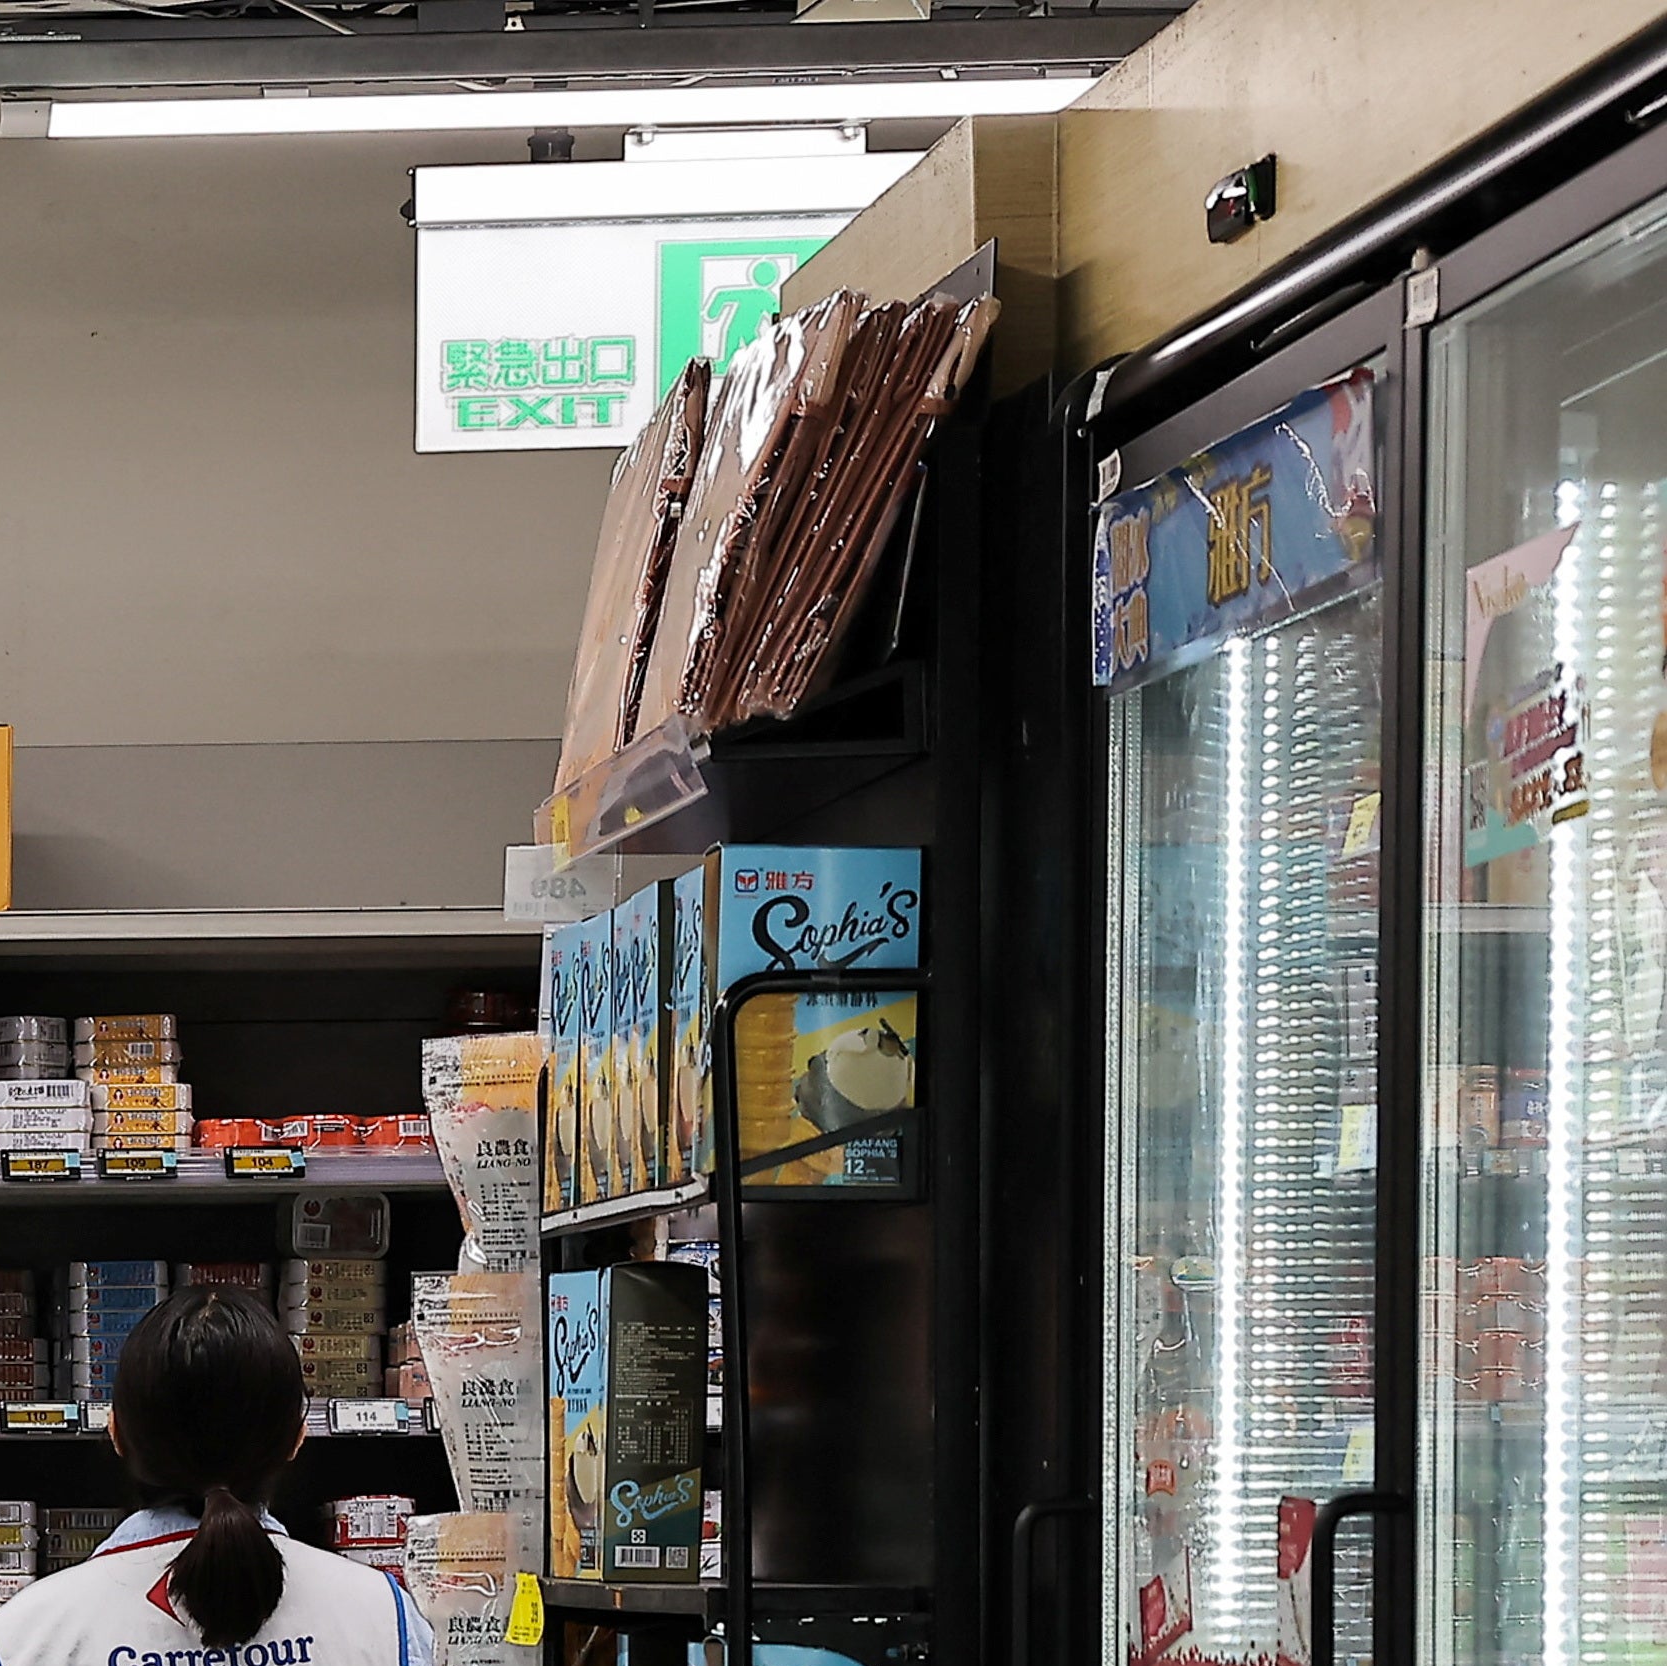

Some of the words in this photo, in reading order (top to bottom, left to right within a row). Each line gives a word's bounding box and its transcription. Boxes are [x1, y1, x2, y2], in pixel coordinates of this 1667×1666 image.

[446, 337, 635, 388] 緊急出口
[457, 393, 627, 428] EXIT
[764, 870, 814, 891] 雅方
[250, 1157, 273, 1169] 104
[845, 1159, 864, 1175] 12
[23, 1411, 48, 1423] 110
[446, 1614, 503, 1633] 良農食
